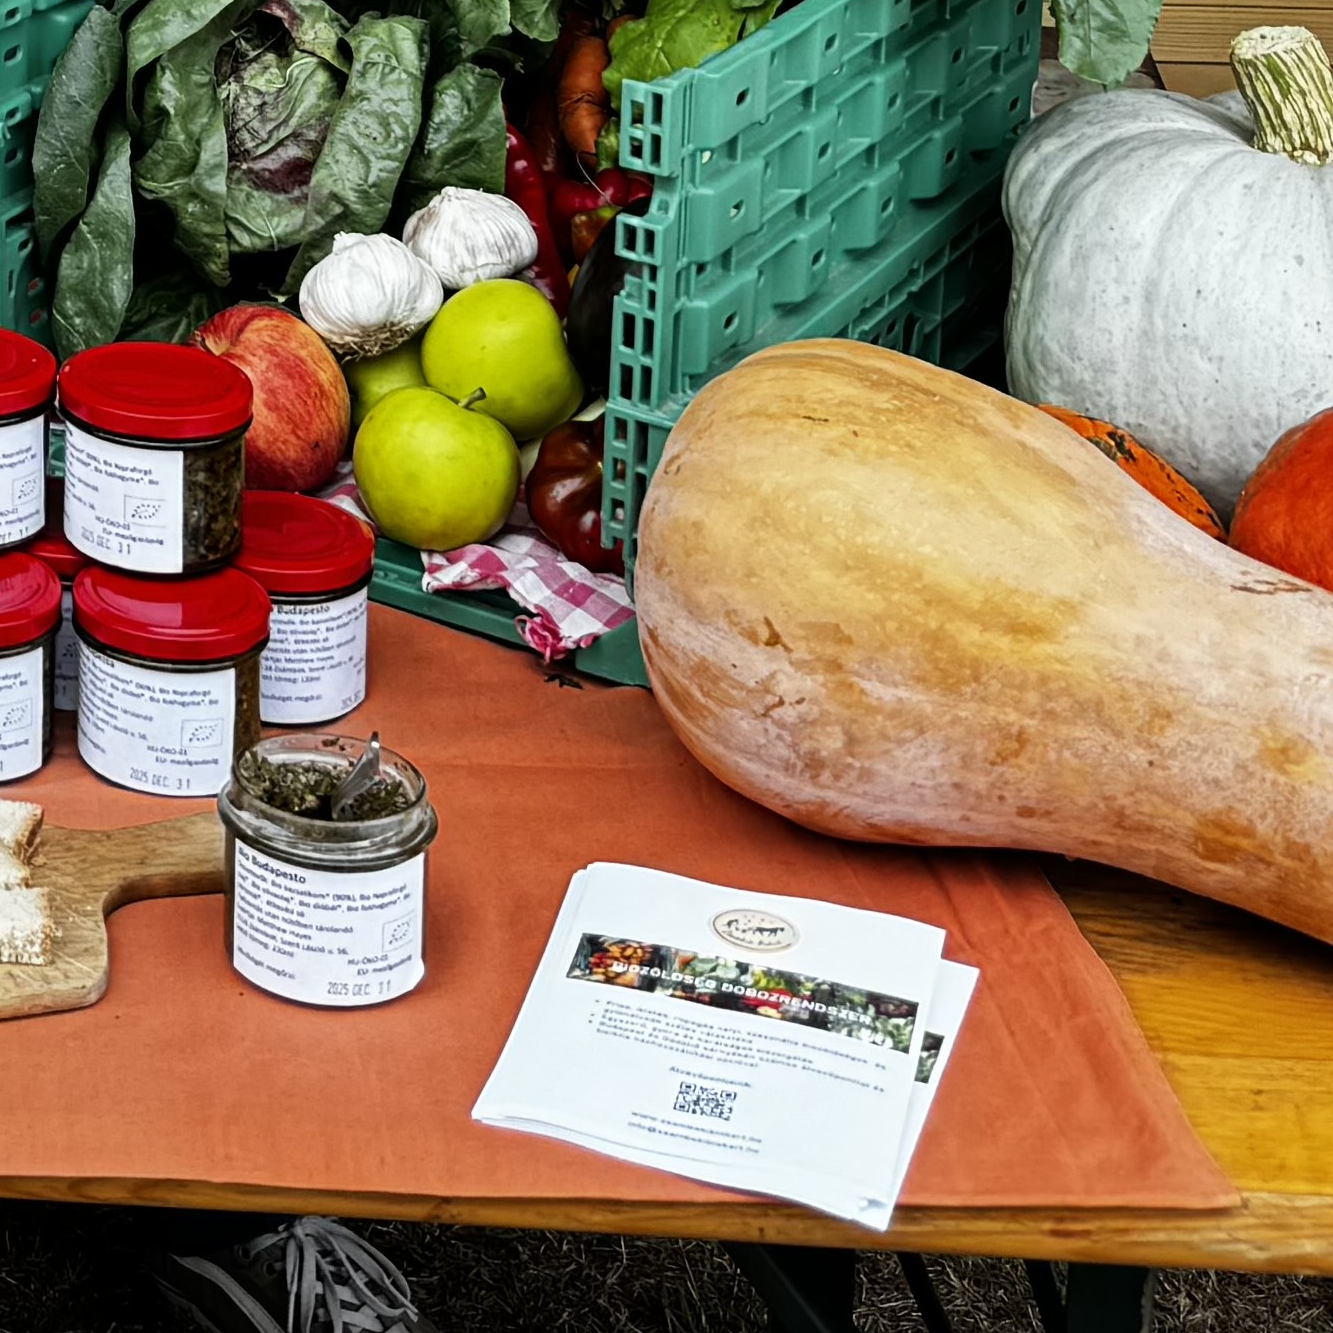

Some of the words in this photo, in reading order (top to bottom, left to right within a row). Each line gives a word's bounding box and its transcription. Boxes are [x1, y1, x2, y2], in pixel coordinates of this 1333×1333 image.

[277, 605, 330, 615] Budapesto
[130, 767, 150, 783] 2025
[176, 778, 191, 790] 31
[252, 855, 306, 884] Budapesto
[327, 981, 349, 996] 2025
